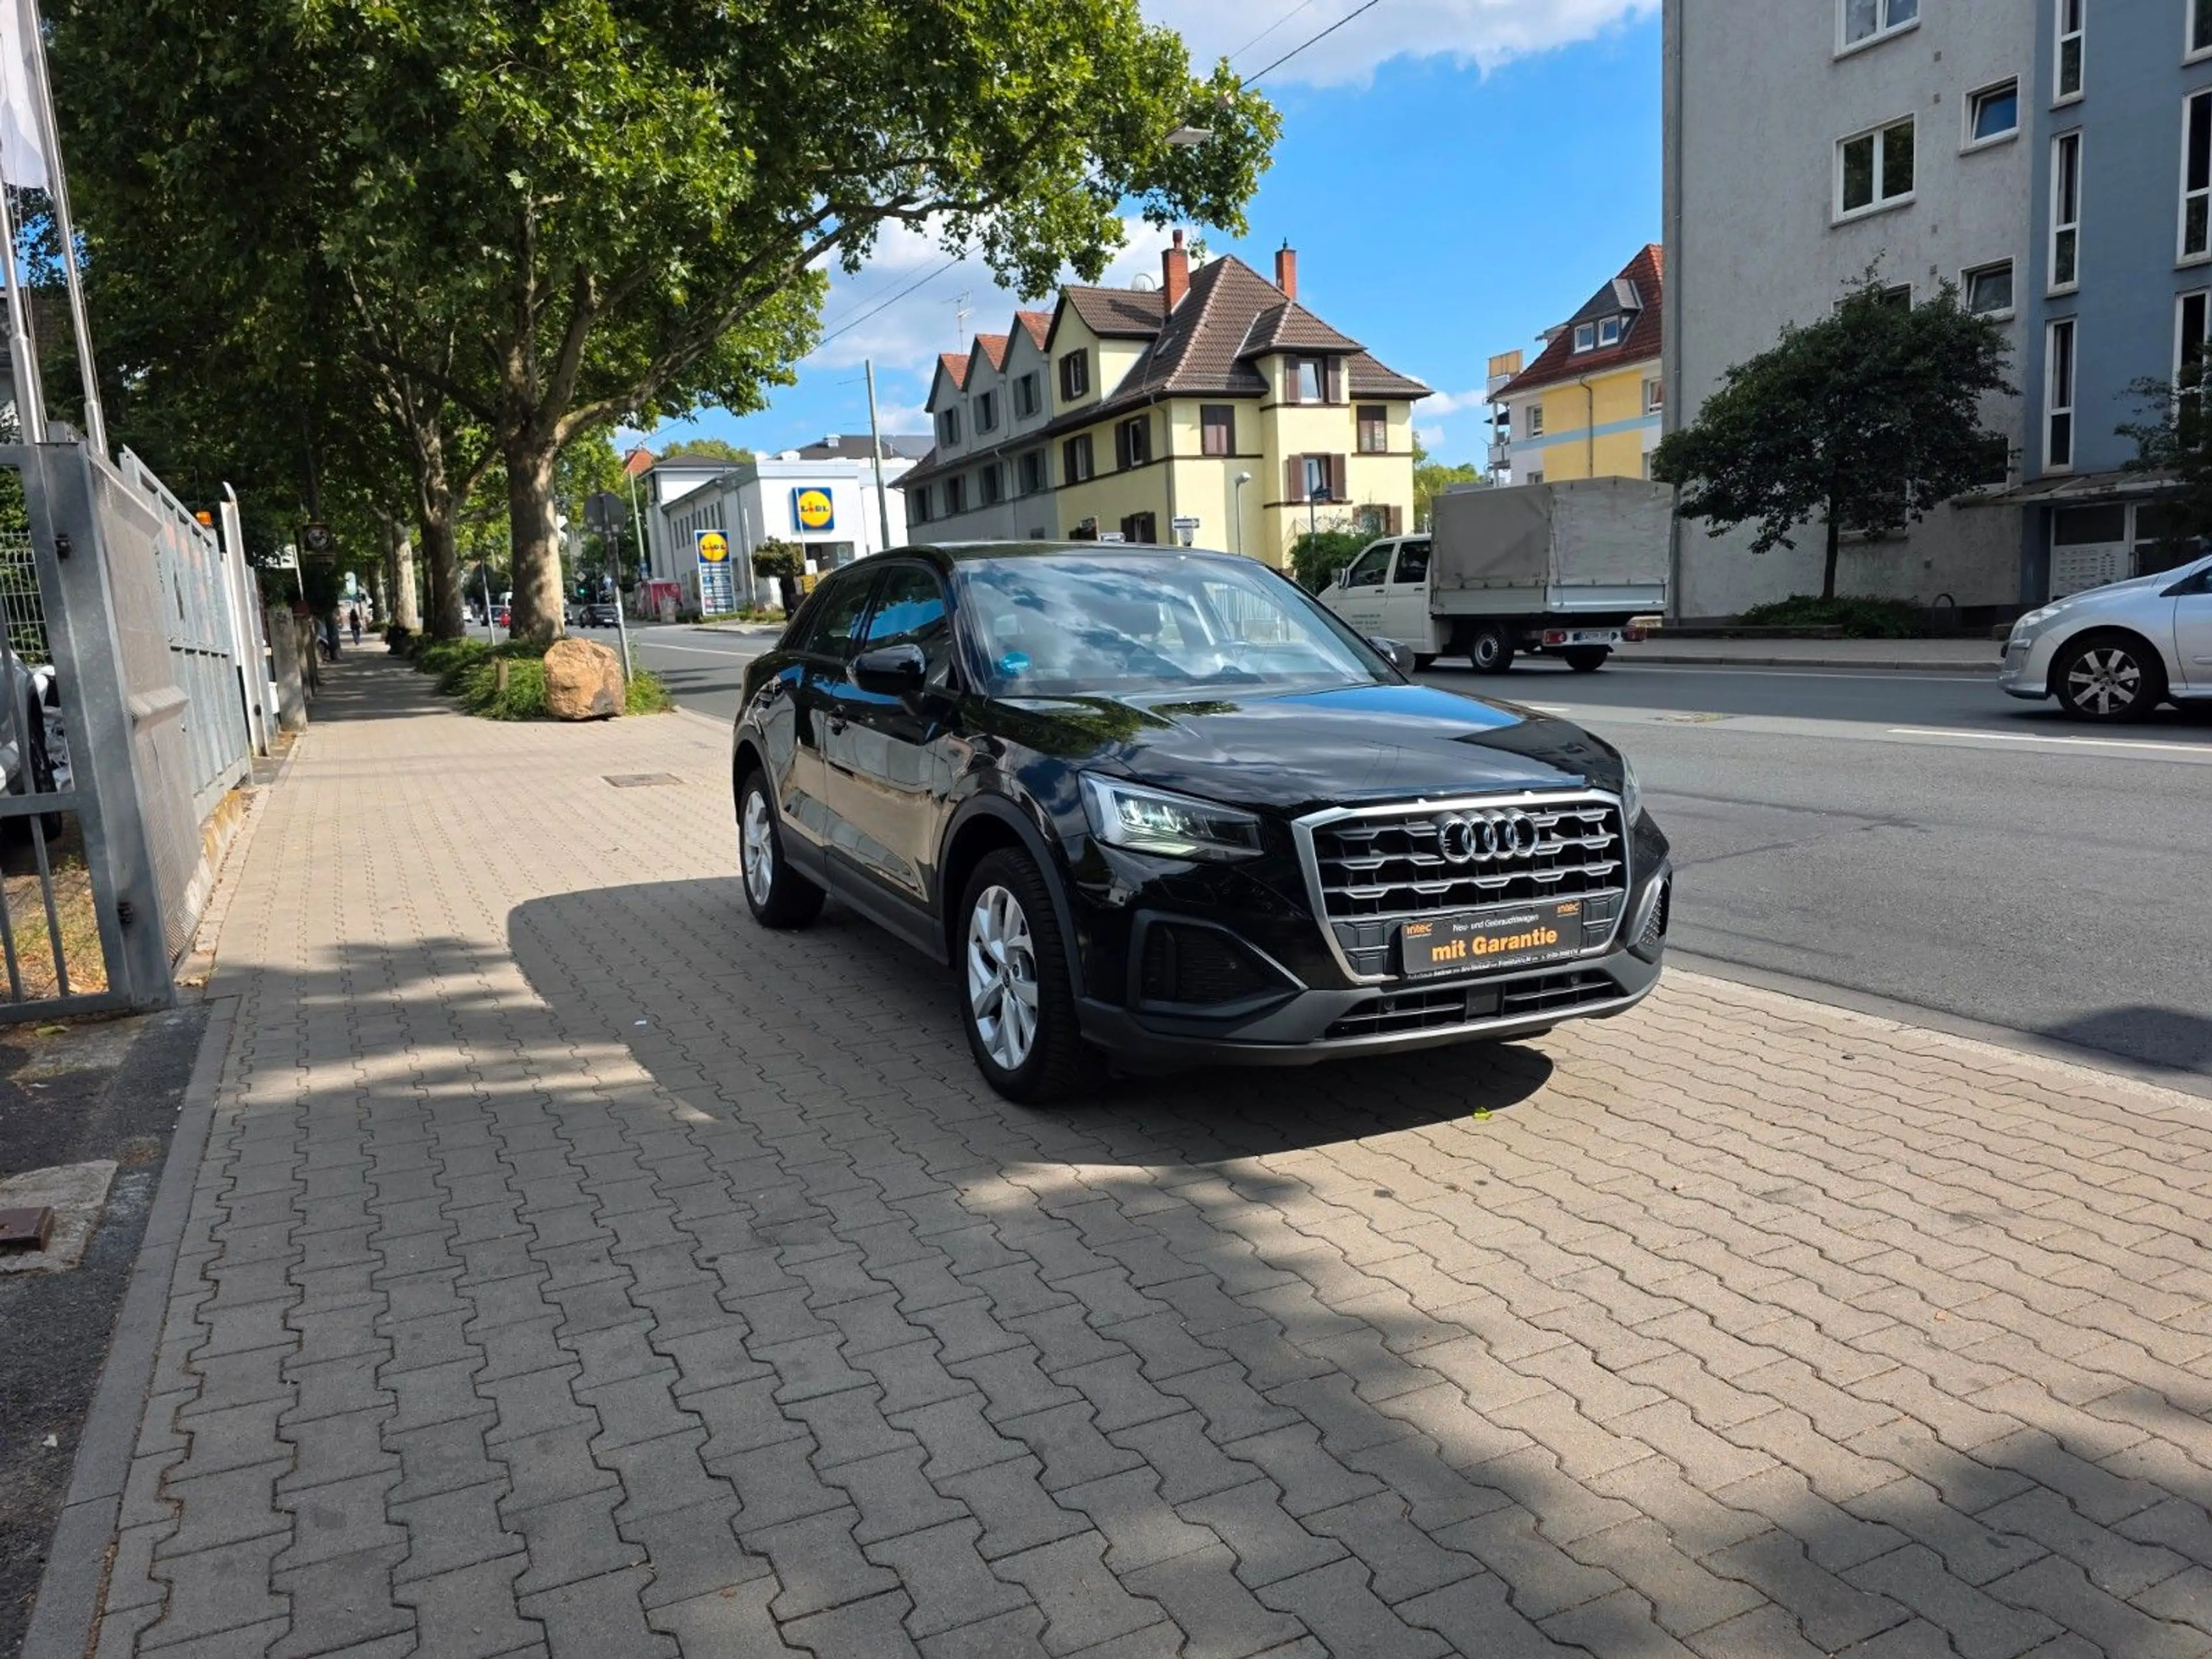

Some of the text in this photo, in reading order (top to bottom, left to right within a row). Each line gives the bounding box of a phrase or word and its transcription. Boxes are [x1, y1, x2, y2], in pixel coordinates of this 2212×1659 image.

[1471, 921, 1484, 930] und
[1484, 914, 1540, 927] Gebrauchtwagen
[1431, 939, 1467, 961] mit
[1471, 926, 1558, 956] Garantie
